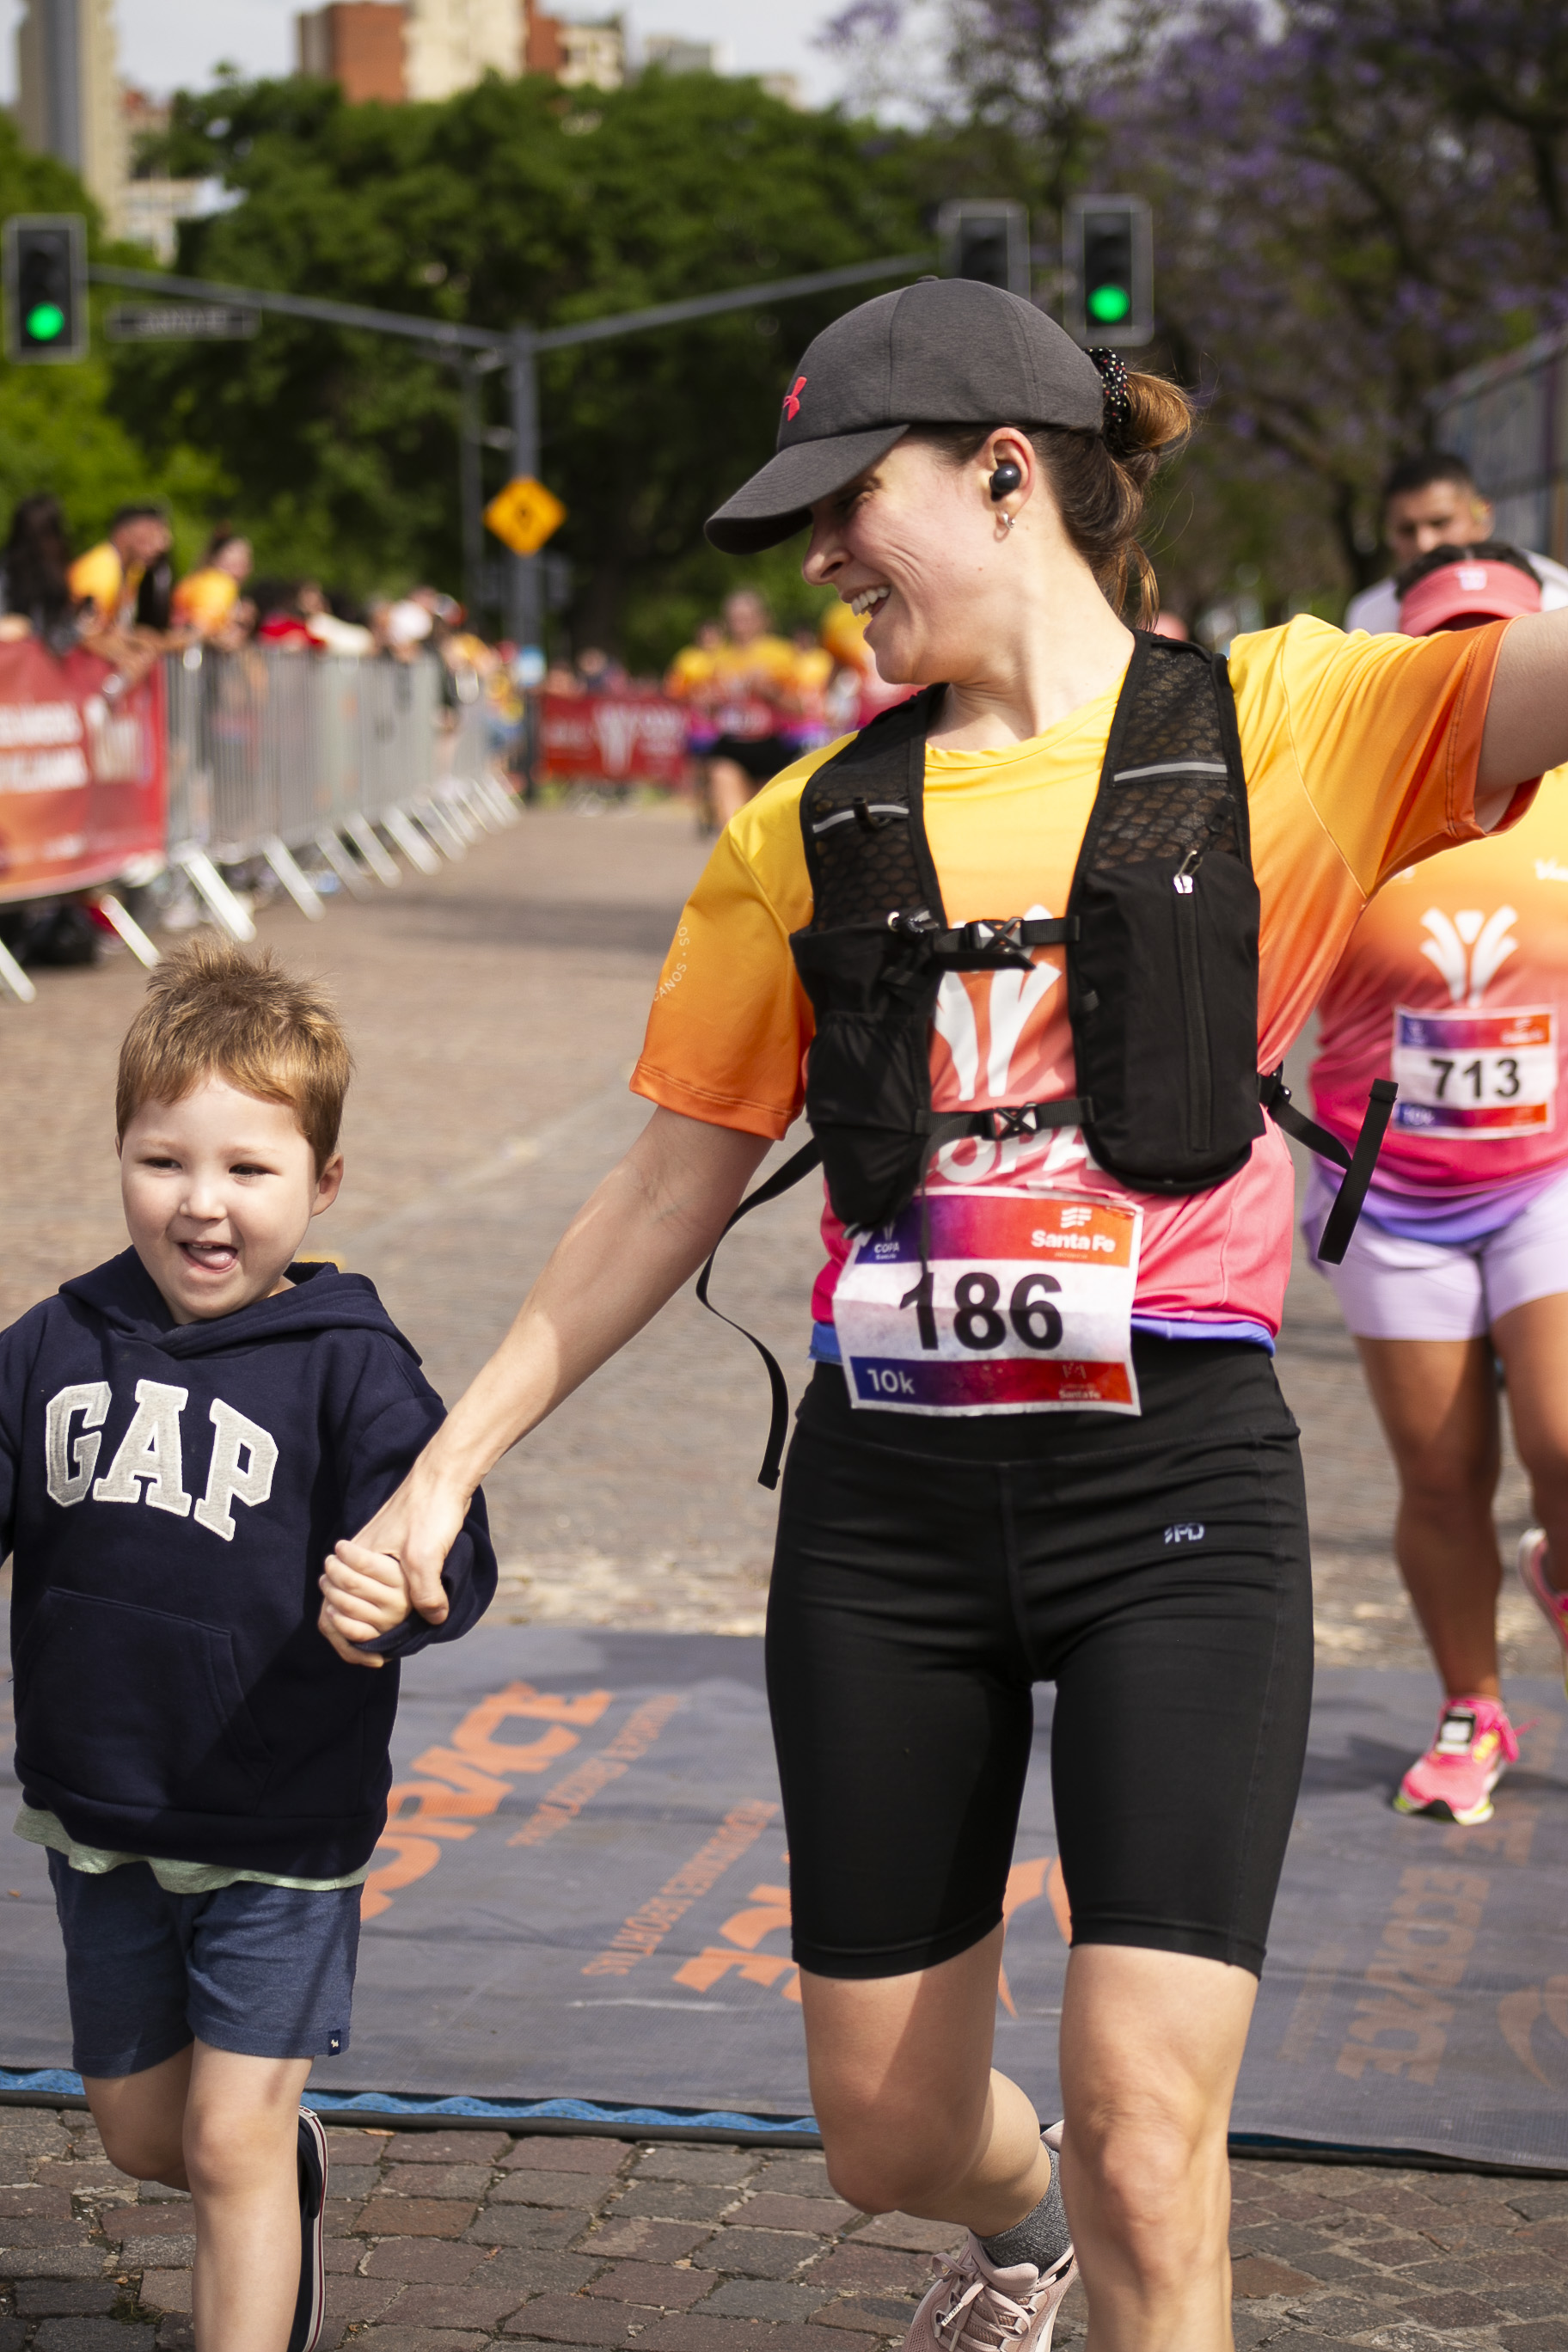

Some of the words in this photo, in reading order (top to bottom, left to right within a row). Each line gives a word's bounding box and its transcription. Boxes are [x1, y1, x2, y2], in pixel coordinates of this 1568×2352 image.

[1430, 1058, 1520, 1099] 713
[936, 1124, 1103, 1184] OPA
[873, 1241, 900, 1253] COPA
[1031, 1229, 1090, 1250] Santa
[1092, 1233, 1117, 1253] Fe
[899, 1272, 1063, 1351] 186
[867, 1369, 916, 1394] 10k
[45, 1378, 279, 1542] GAP
